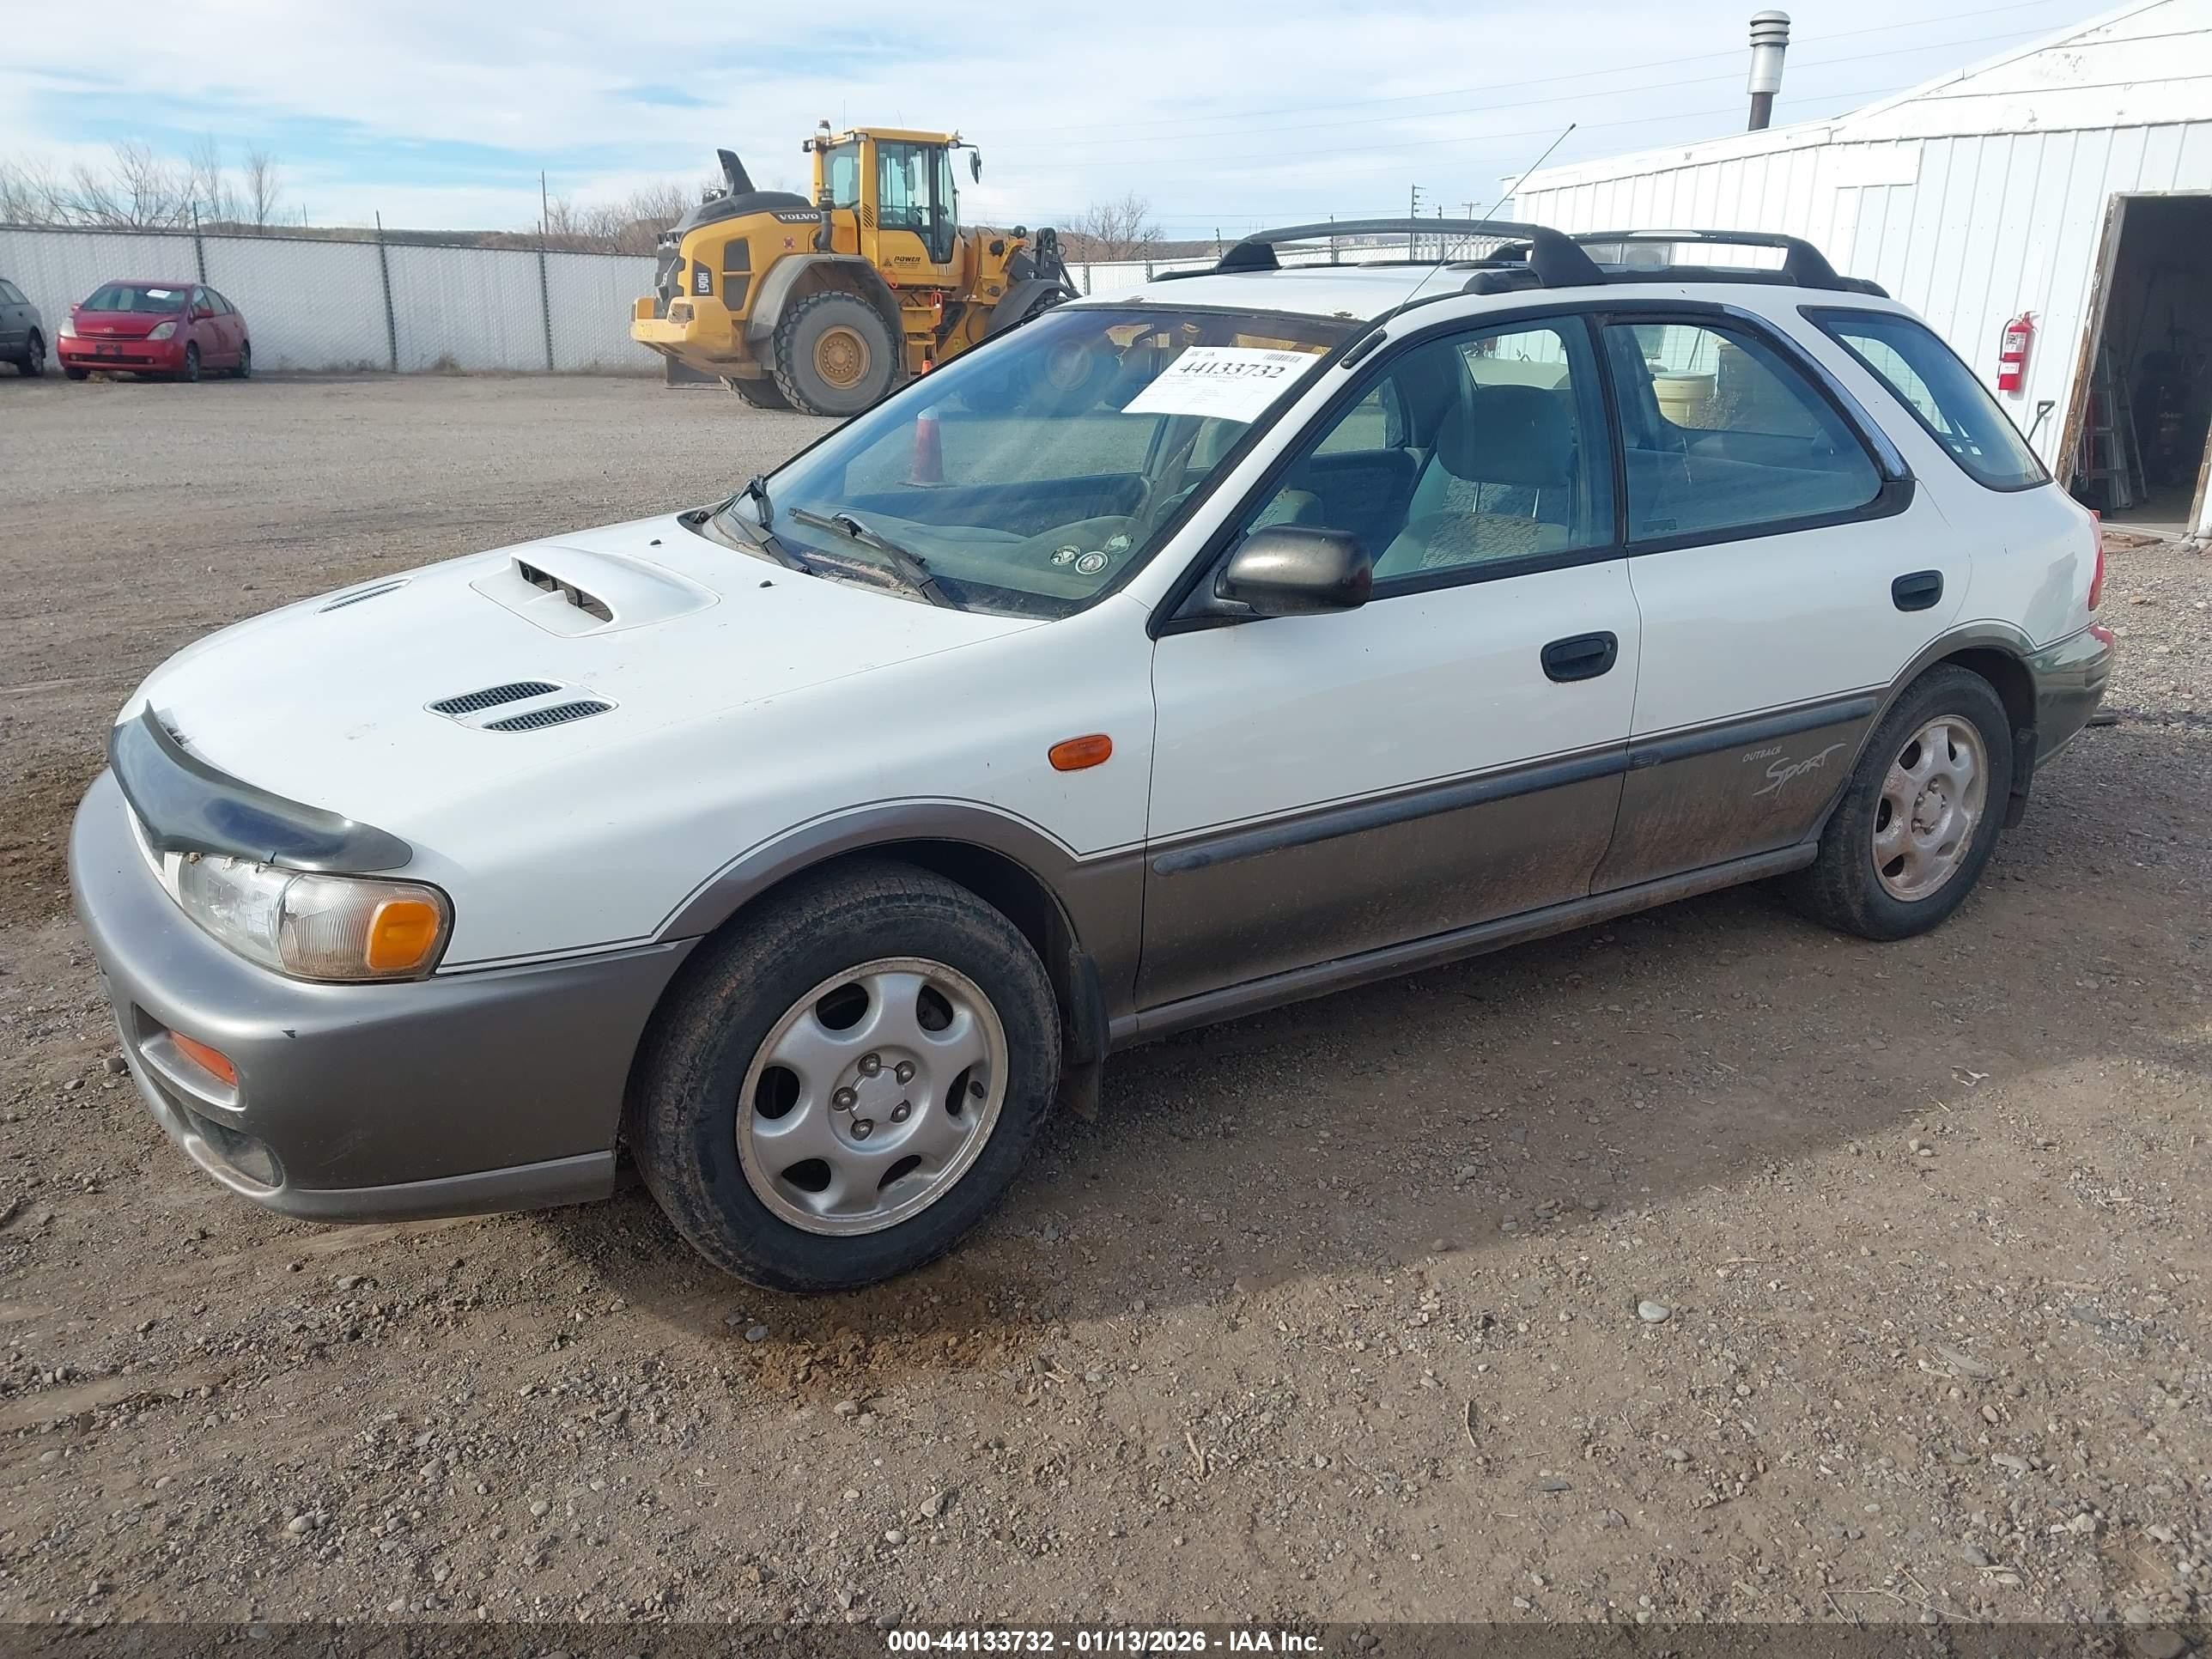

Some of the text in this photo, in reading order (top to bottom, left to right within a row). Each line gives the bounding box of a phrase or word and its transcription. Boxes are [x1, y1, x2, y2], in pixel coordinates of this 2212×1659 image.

[697, 272, 709, 293] L90H
[1179, 362, 1286, 378] 44133732
[1742, 745, 1783, 763] OUTBACK
